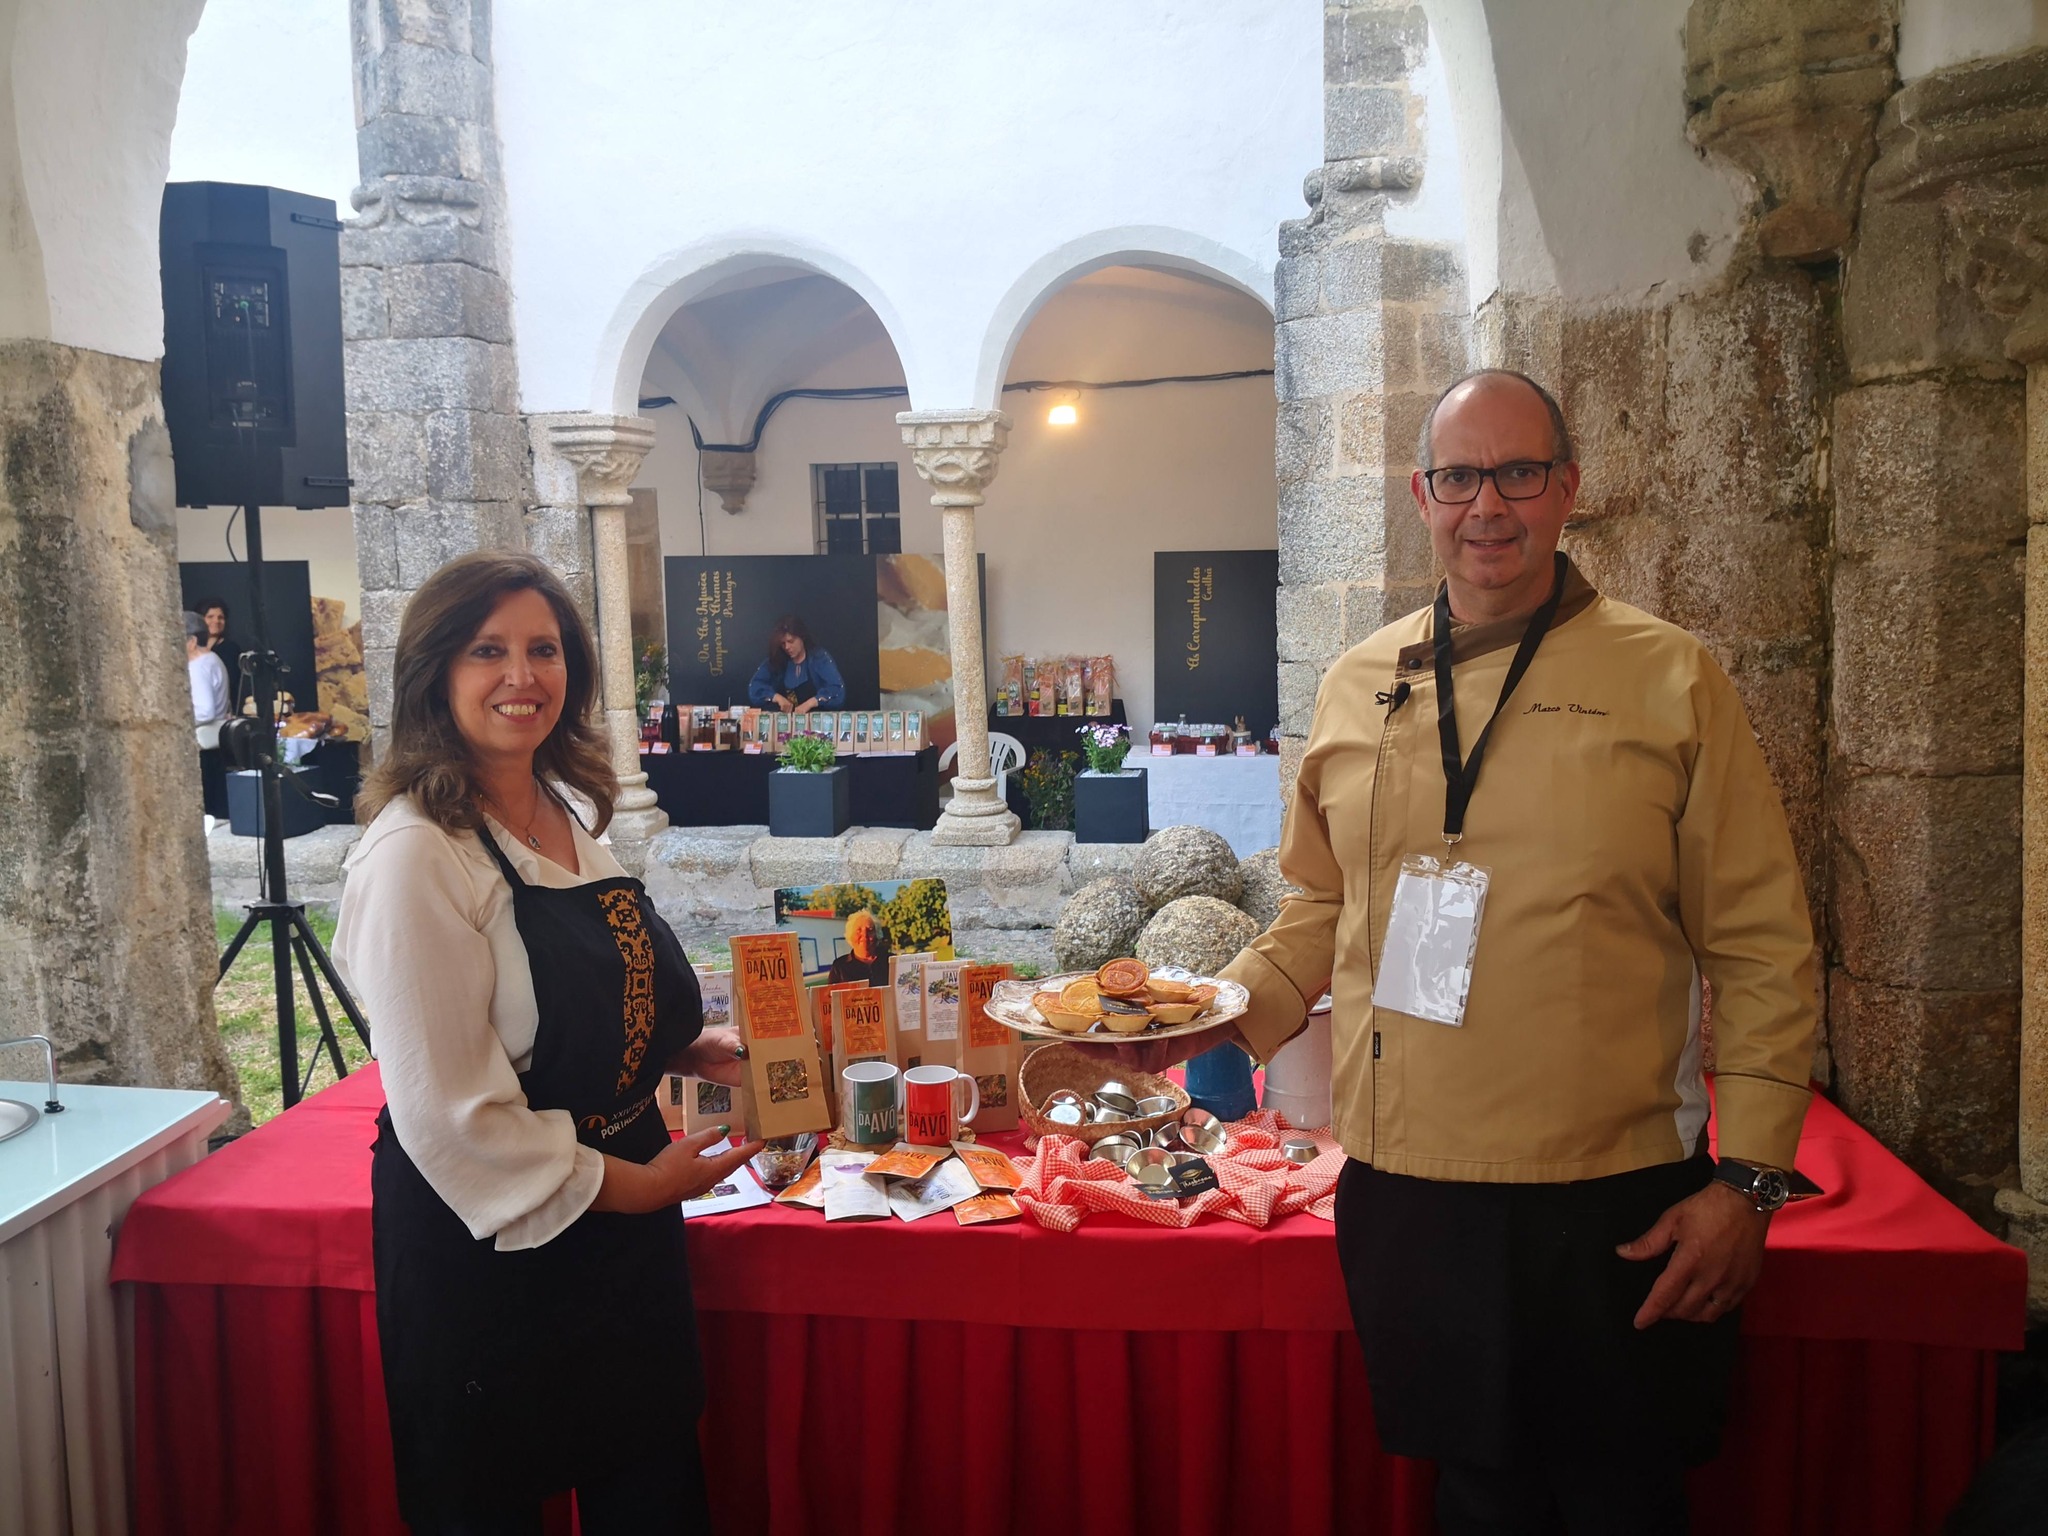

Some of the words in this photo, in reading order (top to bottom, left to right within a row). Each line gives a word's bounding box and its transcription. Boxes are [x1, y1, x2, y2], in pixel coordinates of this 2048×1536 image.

[696, 571, 713, 615] Infusões
[709, 571, 721, 616] Aromas
[722, 571, 737, 618] Portalegre
[1201, 567, 1213, 600] Covilhã
[1186, 567, 1206, 651] Carapinhadas
[696, 617, 709, 640] Avó
[697, 643, 710, 663] Da
[709, 627, 728, 677] Temperos
[1186, 653, 1200, 671] As
[1523, 703, 1561, 715] Marco
[746, 960, 759, 974] DA
[759, 952, 787, 981] AVÓ
[948, 971, 958, 983] AV
[716, 994, 729, 1005] AVÓ
[969, 982, 980, 994] DA
[845, 1008, 856, 1019] DA
[856, 1002, 880, 1025] AVÓ
[858, 1113, 871, 1126] DA
[870, 1104, 895, 1134] AVÓ
[909, 1113, 919, 1128] DA
[919, 1110, 947, 1136] AVÓ
